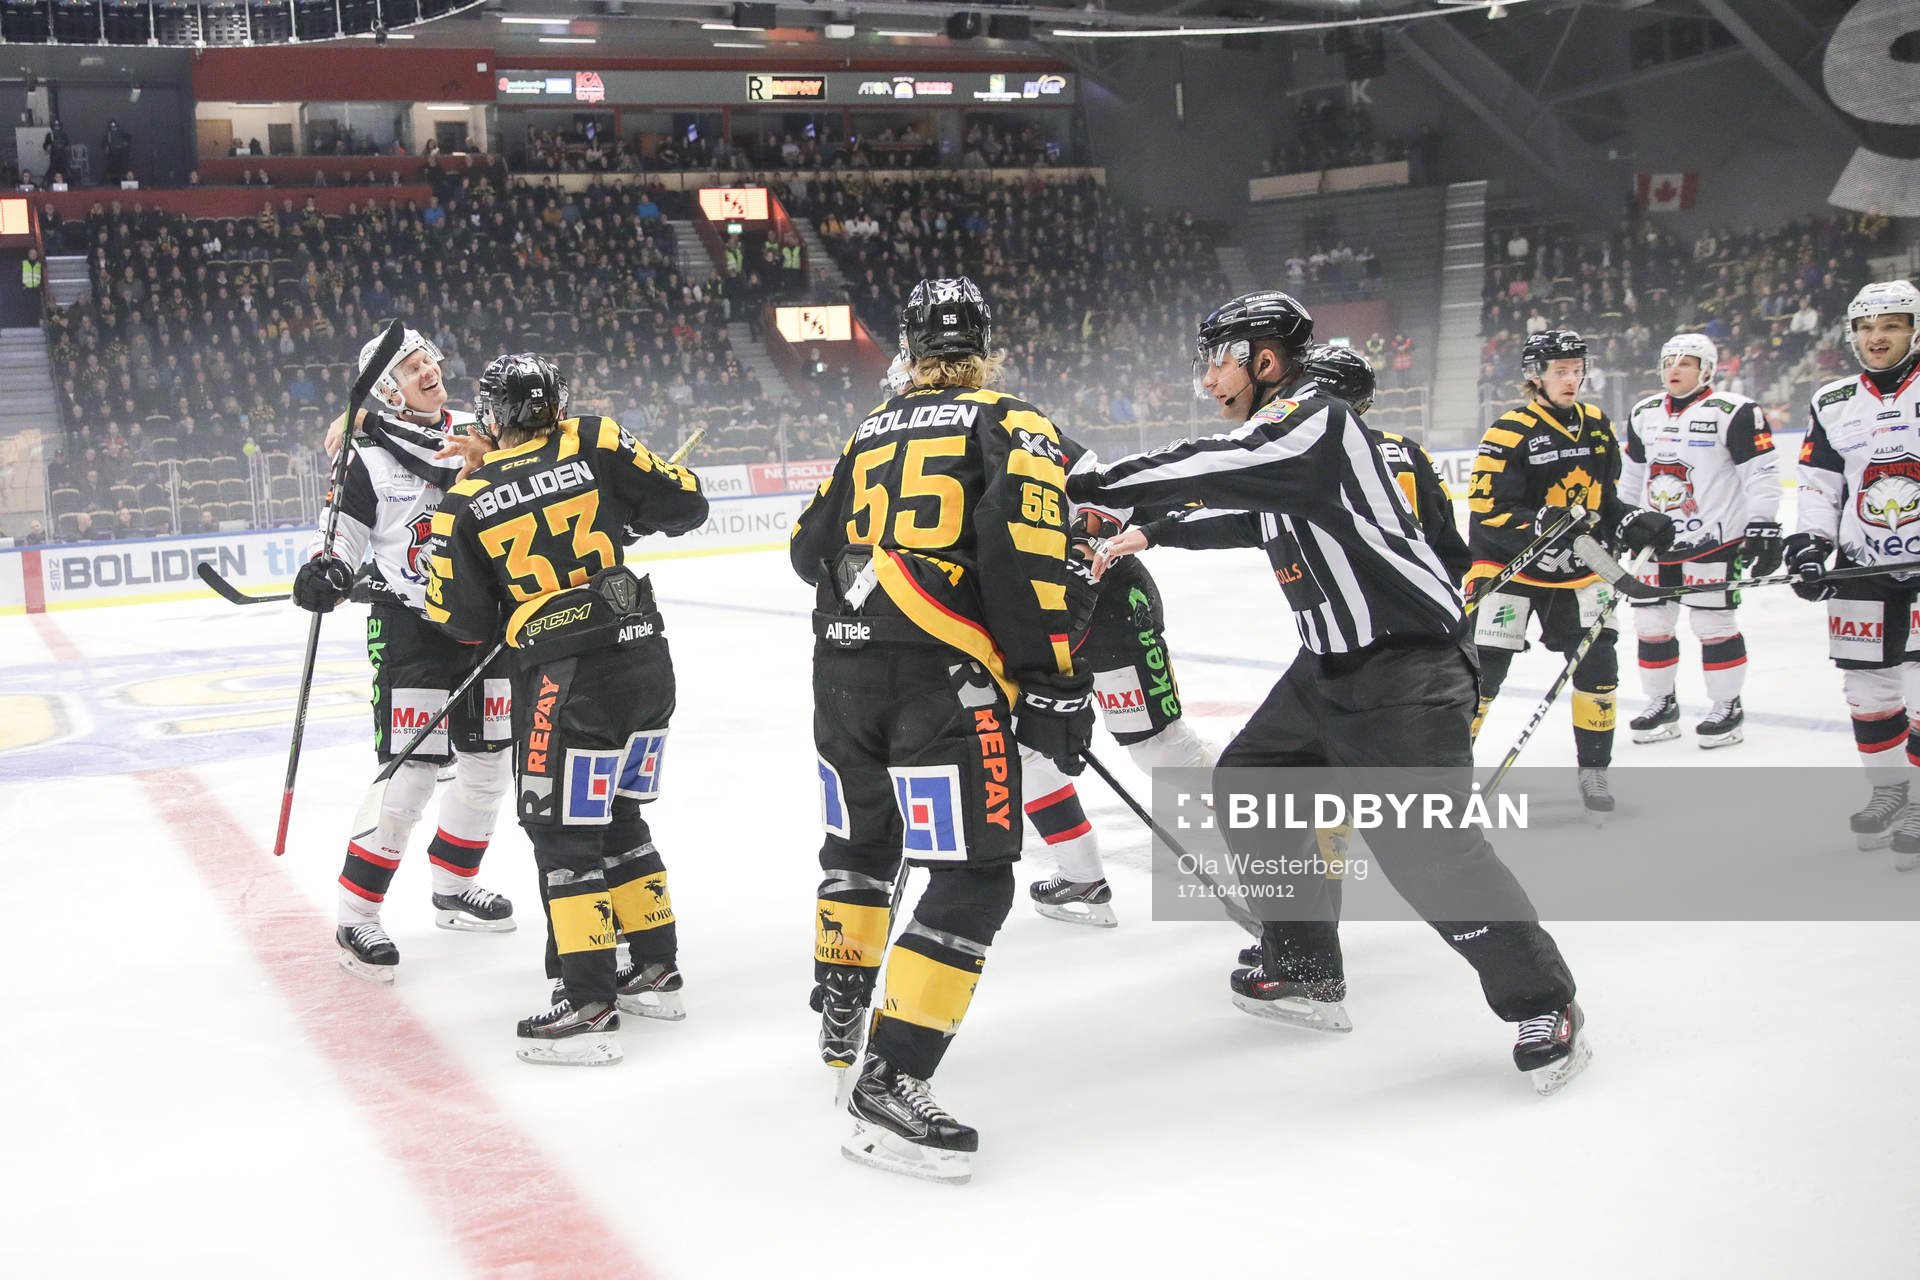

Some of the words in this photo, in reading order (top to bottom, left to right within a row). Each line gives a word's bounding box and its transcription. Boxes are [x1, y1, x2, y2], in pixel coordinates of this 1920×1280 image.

[942, 313, 958, 325] 55
[1250, 319, 1270, 327] CCM
[530, 388, 544, 399] 33
[1313, 376, 1338, 385] CCM
[857, 404, 979, 442] BOLIDEN
[1690, 422, 1717, 433] RSA
[501, 456, 540, 471] CCM
[475, 460, 595, 518] BOLIDEN
[846, 434, 967, 549] 55
[1021, 481, 1063, 527] 55
[690, 512, 788, 538] AIDING
[477, 488, 617, 603] 33
[63, 544, 248, 590] BOLIDEN
[1500, 548, 1534, 581] CCM
[525, 602, 593, 636] CCM
[825, 622, 871, 641] AllTele
[1828, 615, 1884, 638] MAXI
[617, 622, 654, 643] AllTele
[527, 674, 560, 774] REPAY
[973, 709, 1011, 832] REPAY
[1453, 926, 1489, 941] CCM
